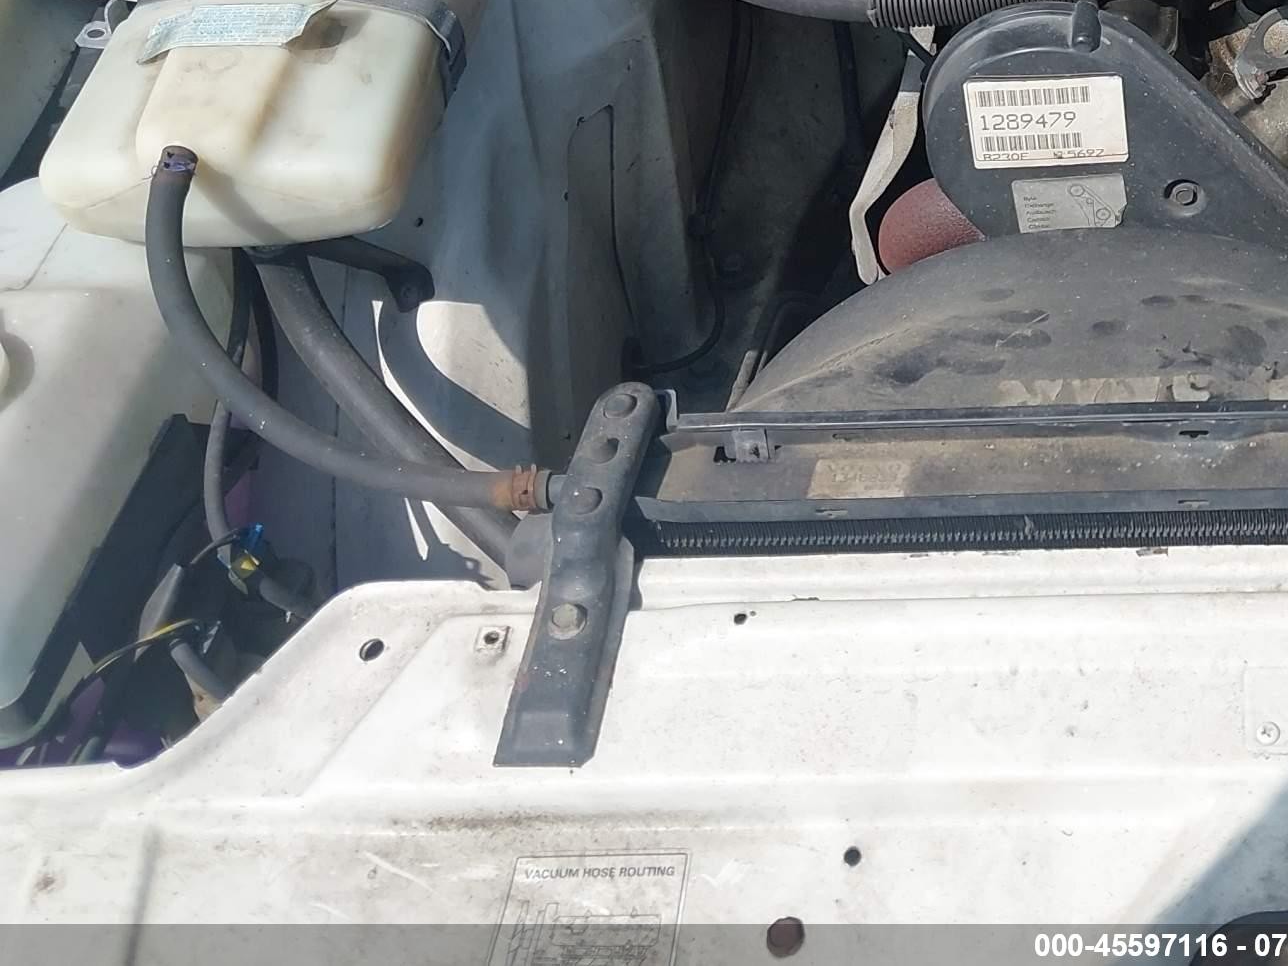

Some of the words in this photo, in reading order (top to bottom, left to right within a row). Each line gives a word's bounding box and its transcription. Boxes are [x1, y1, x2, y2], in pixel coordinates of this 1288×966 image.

[979, 111, 1077, 131] 1289479
[524, 867, 580, 880] VACUUM
[582, 866, 616, 879] HOSE
[618, 865, 676, 877] ROUTING
